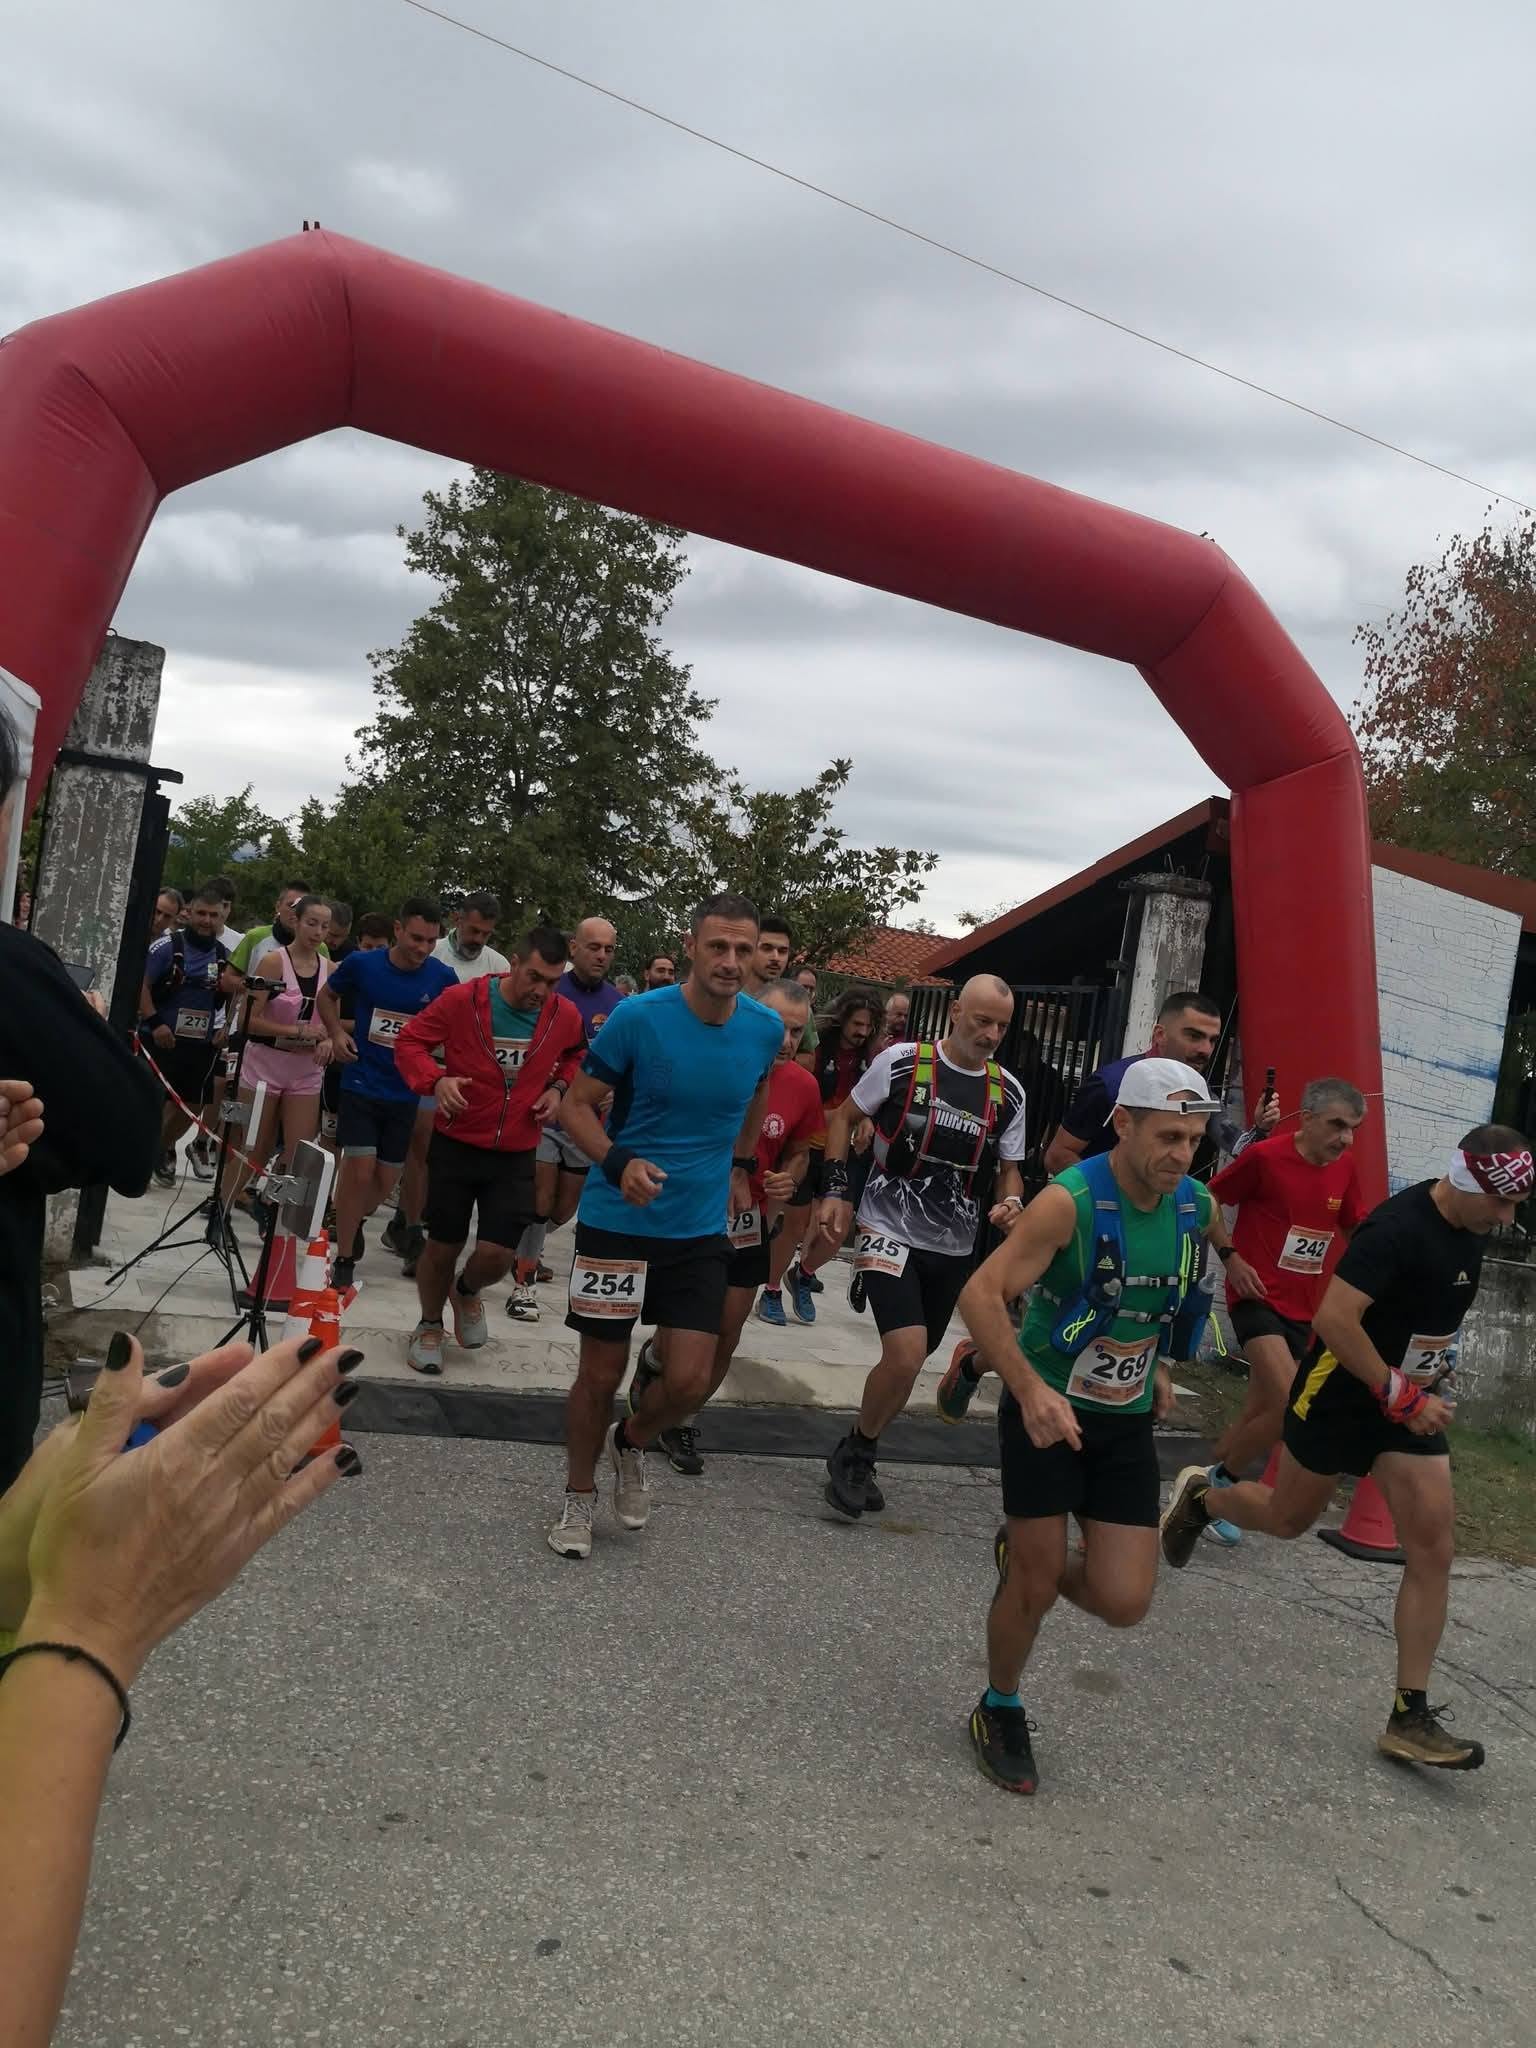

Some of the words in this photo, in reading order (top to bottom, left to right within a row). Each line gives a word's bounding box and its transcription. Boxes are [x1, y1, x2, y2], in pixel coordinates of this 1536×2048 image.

[185, 1016, 208, 1029] 273
[379, 1019, 402, 1034] 25
[860, 1235, 900, 1257] 245
[1294, 1238, 1325, 1257] 242
[581, 1271, 635, 1297] 254
[1091, 1352, 1147, 1382] 269
